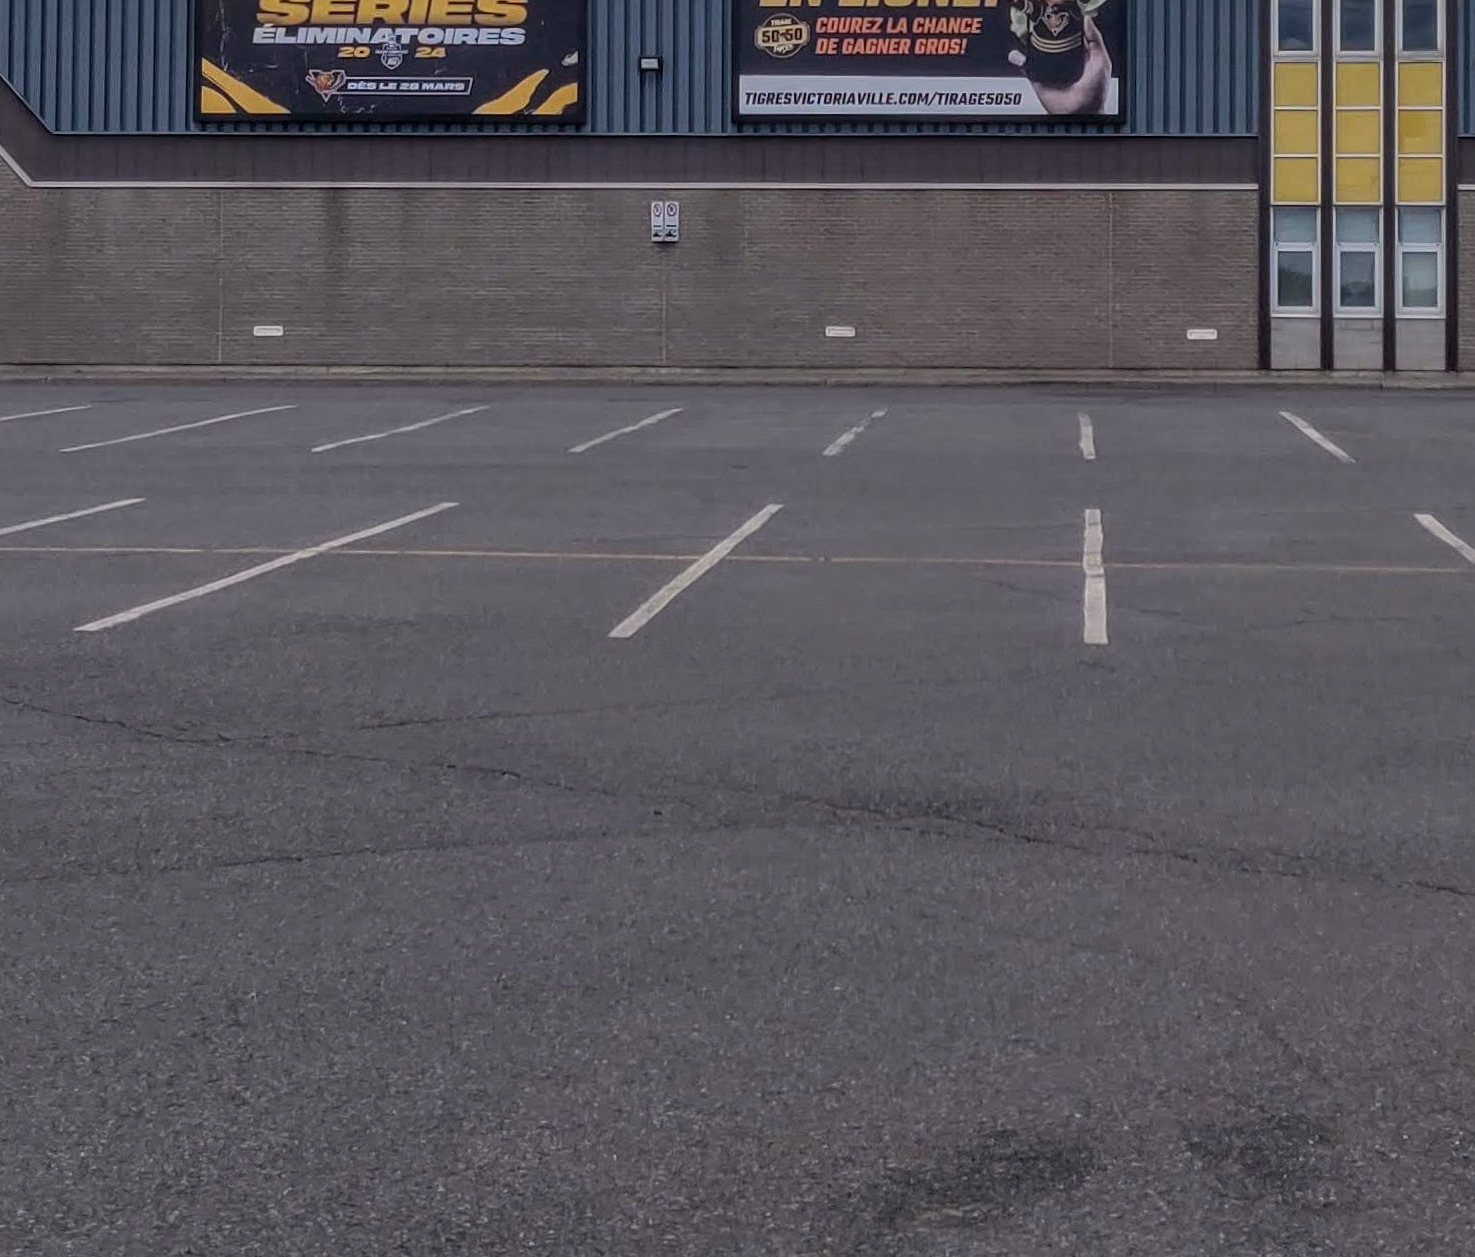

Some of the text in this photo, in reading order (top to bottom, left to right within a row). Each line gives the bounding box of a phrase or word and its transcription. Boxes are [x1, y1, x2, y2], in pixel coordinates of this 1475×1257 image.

[815, 17, 983, 34] COUREZ LA CHANCE
[252, 24, 527, 45] ÉLIMINATOIRES
[762, 28, 803, 43] 50-50
[337, 46, 371, 58] 20
[415, 46, 447, 59] 24
[815, 38, 968, 55] DE GAGNER GROS!
[347, 80, 377, 90] DÈS
[378, 82, 398, 90] LE
[421, 82, 465, 91] MARS
[744, 91, 1023, 106] TIGRESVICTORIAVILLE.COM/TIRAGE5050
